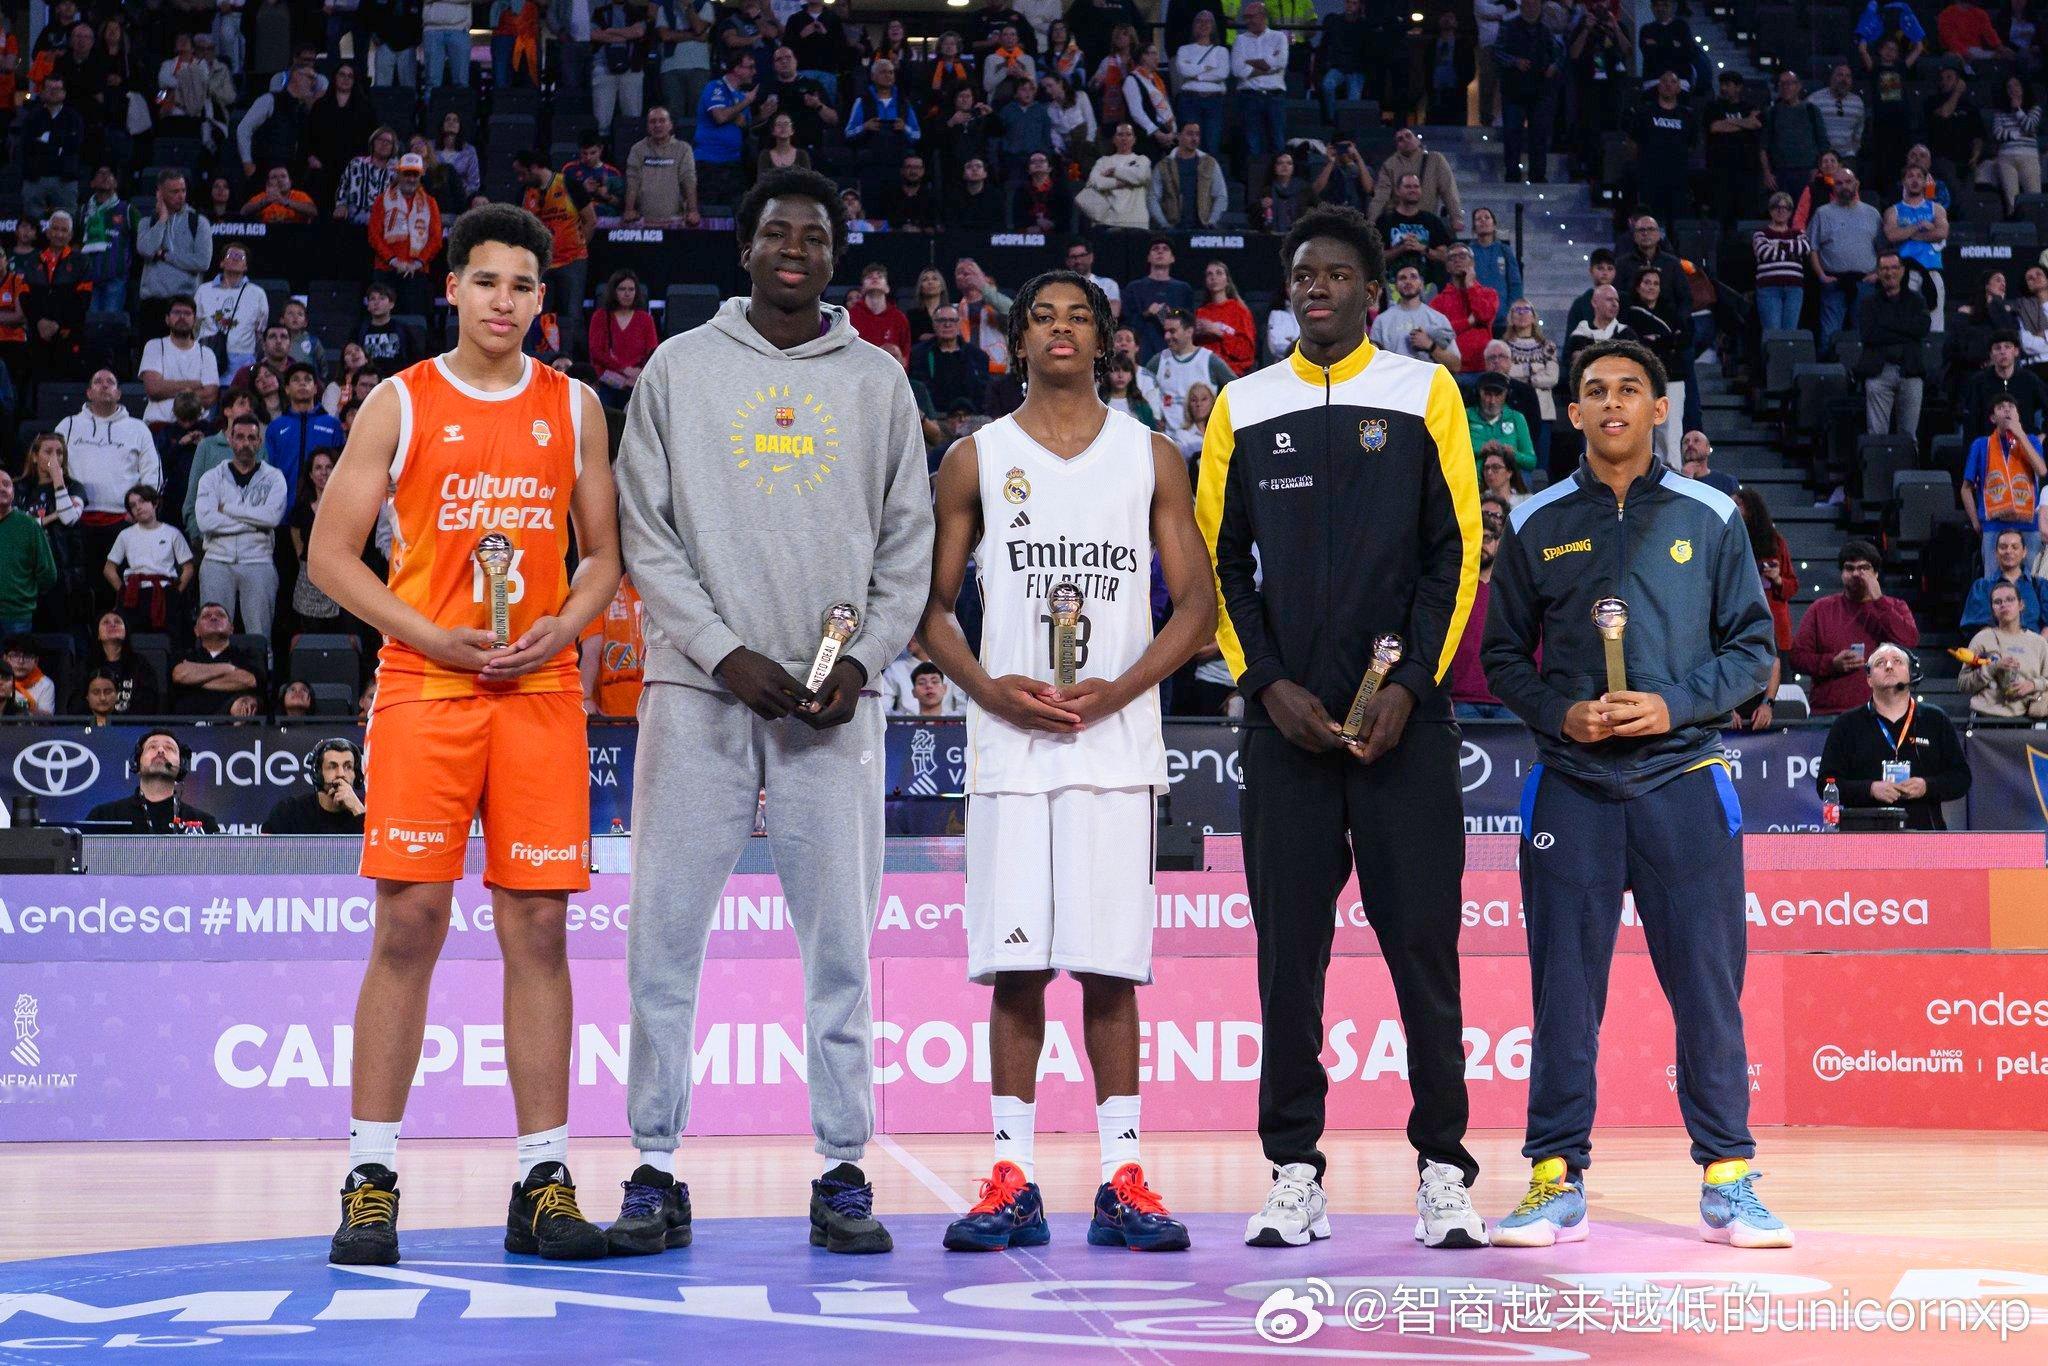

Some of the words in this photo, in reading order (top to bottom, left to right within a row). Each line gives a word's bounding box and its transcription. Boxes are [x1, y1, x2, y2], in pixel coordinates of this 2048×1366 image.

[1652, 116, 1682, 130] VANS
[755, 433, 814, 458] BARÇA
[440, 471, 538, 500] Cultura
[1270, 475, 1313, 485] FUNDACIÓN
[1281, 480, 1314, 489] CANARIAS
[1006, 535, 1137, 573] Emirates
[1542, 538, 1592, 562] SPALDING
[389, 827, 444, 843] PULEVA
[19, 897, 191, 933] endesa
[1770, 892, 1929, 927] endesa
[213, 1023, 630, 1088] CAPEN
[1814, 1048, 1963, 1076] mediolanum
[1930, 1049, 1963, 1058] BANCO
